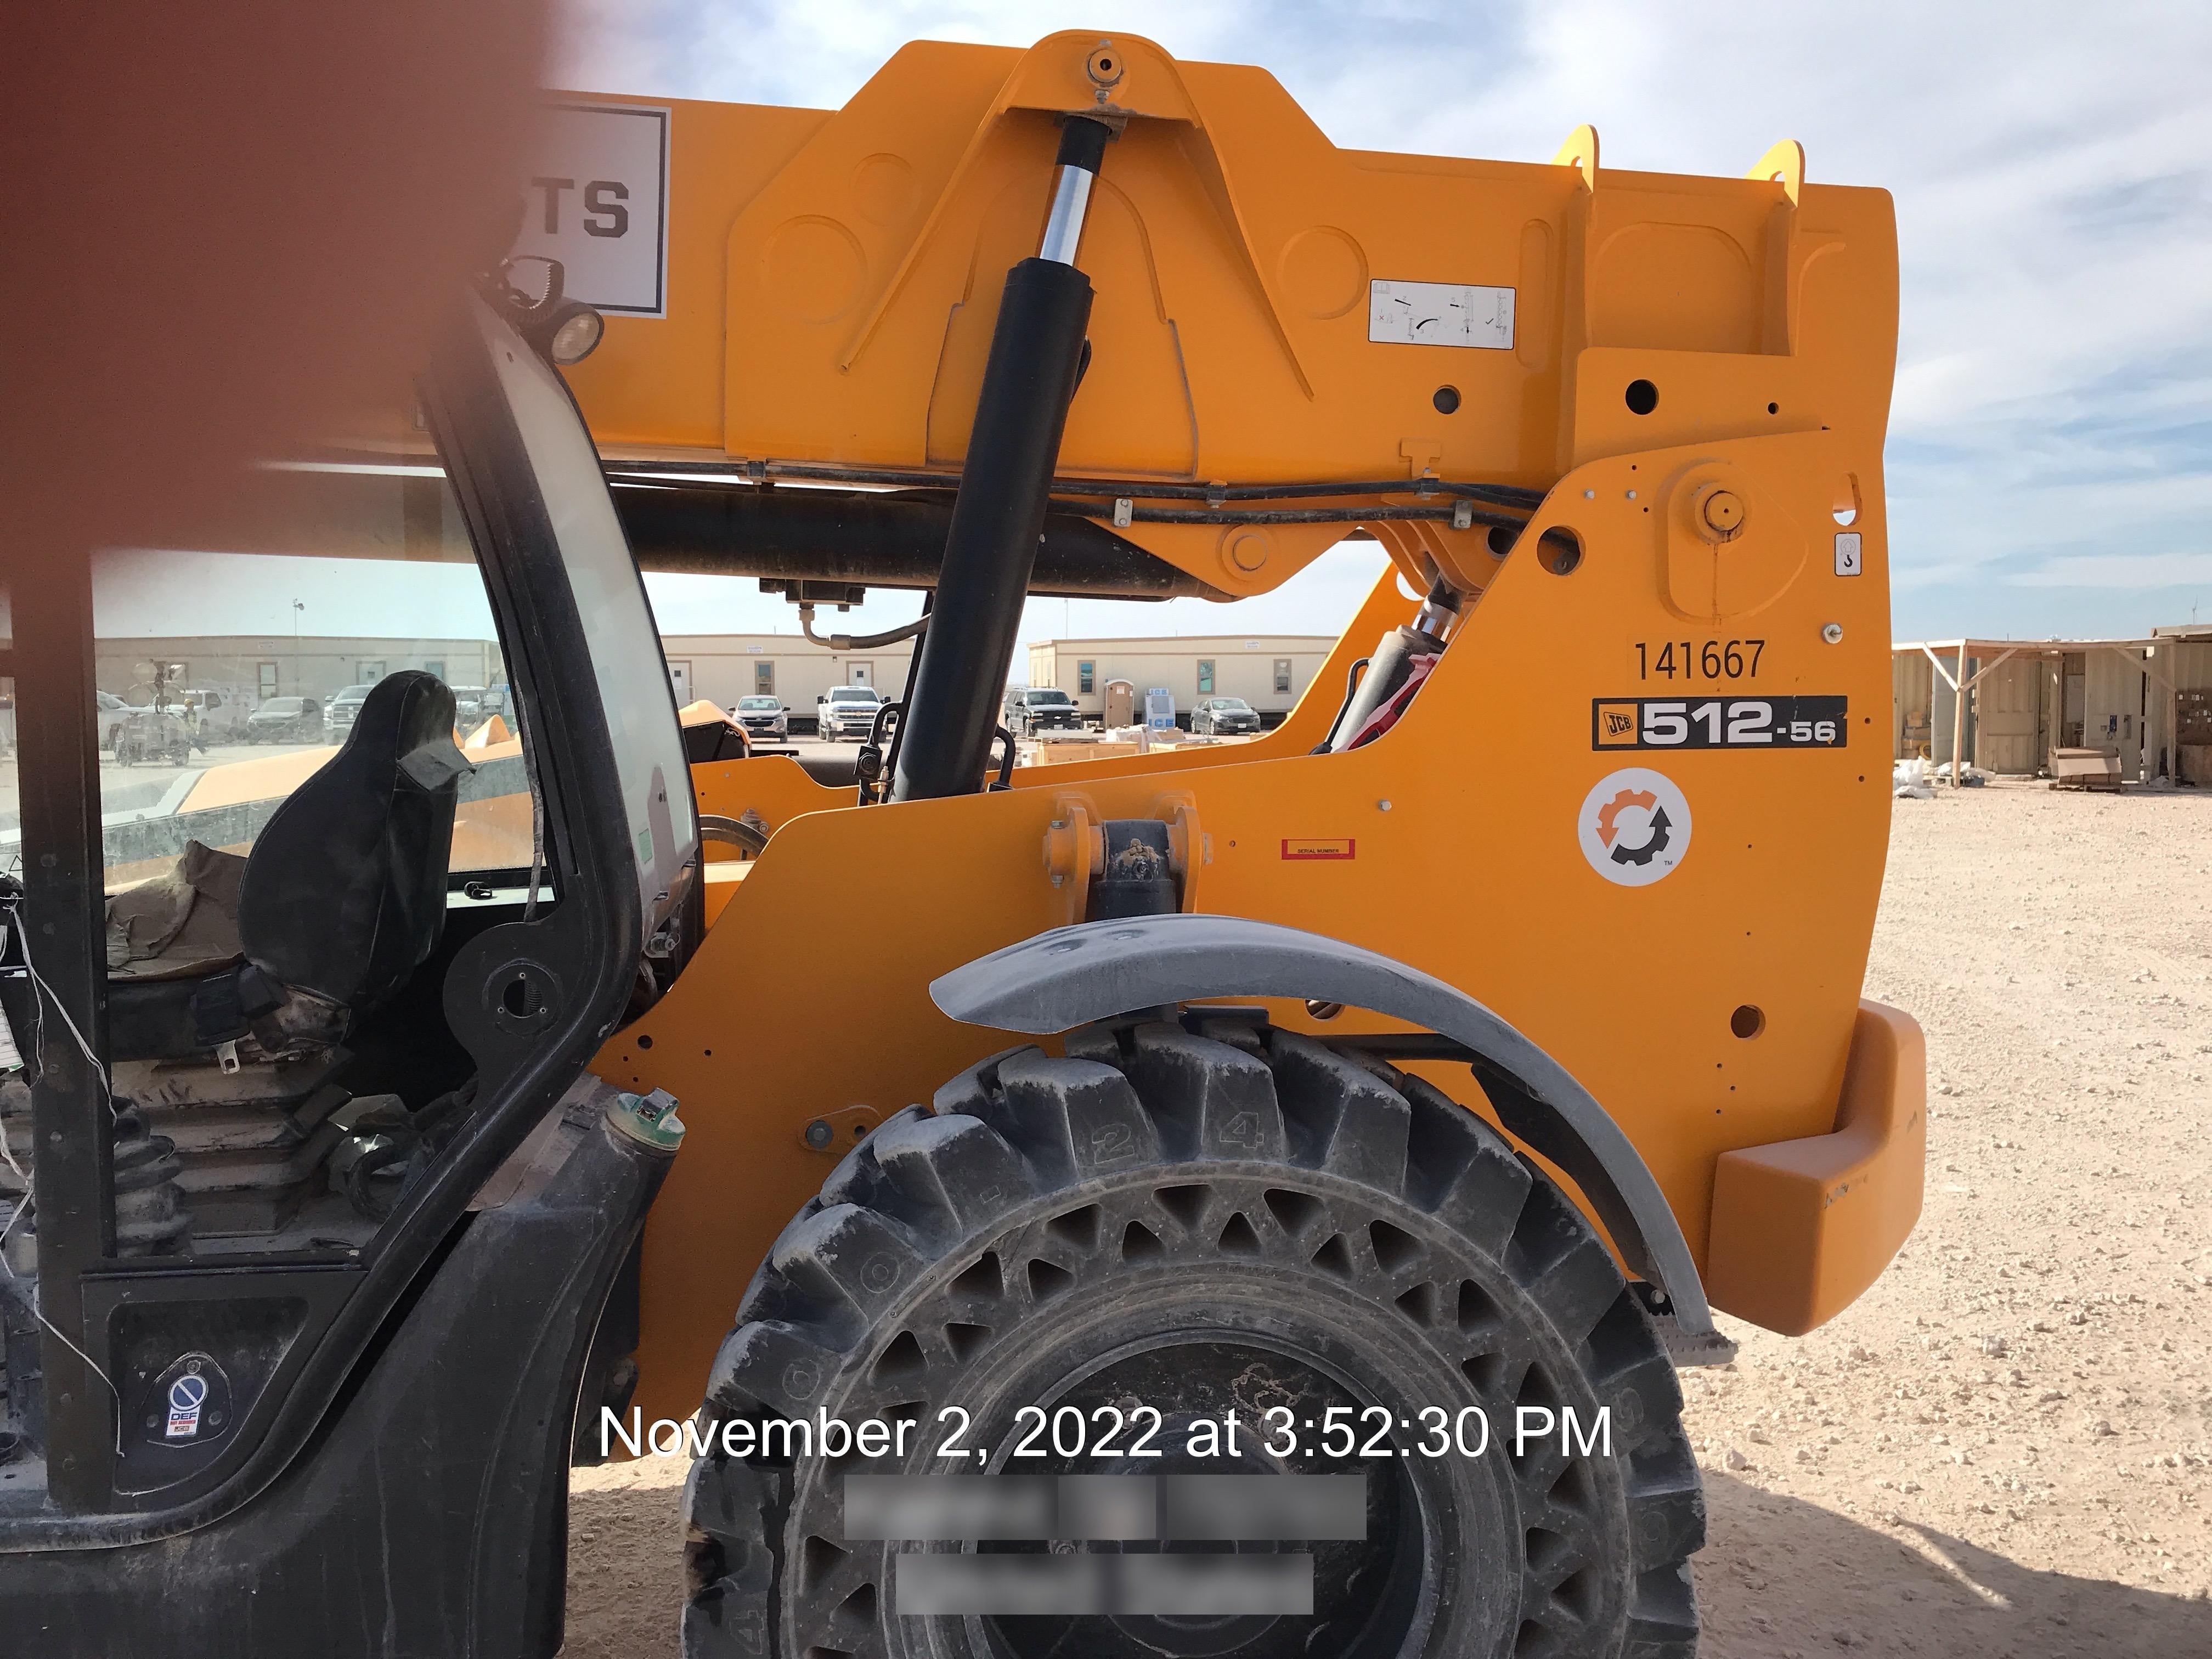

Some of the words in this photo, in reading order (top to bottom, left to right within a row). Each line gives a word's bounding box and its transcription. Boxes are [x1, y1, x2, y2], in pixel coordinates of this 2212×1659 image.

[1635, 639, 1765, 680] 141667
[1149, 719, 1174, 727] ICE
[1609, 714, 1632, 734] JCB
